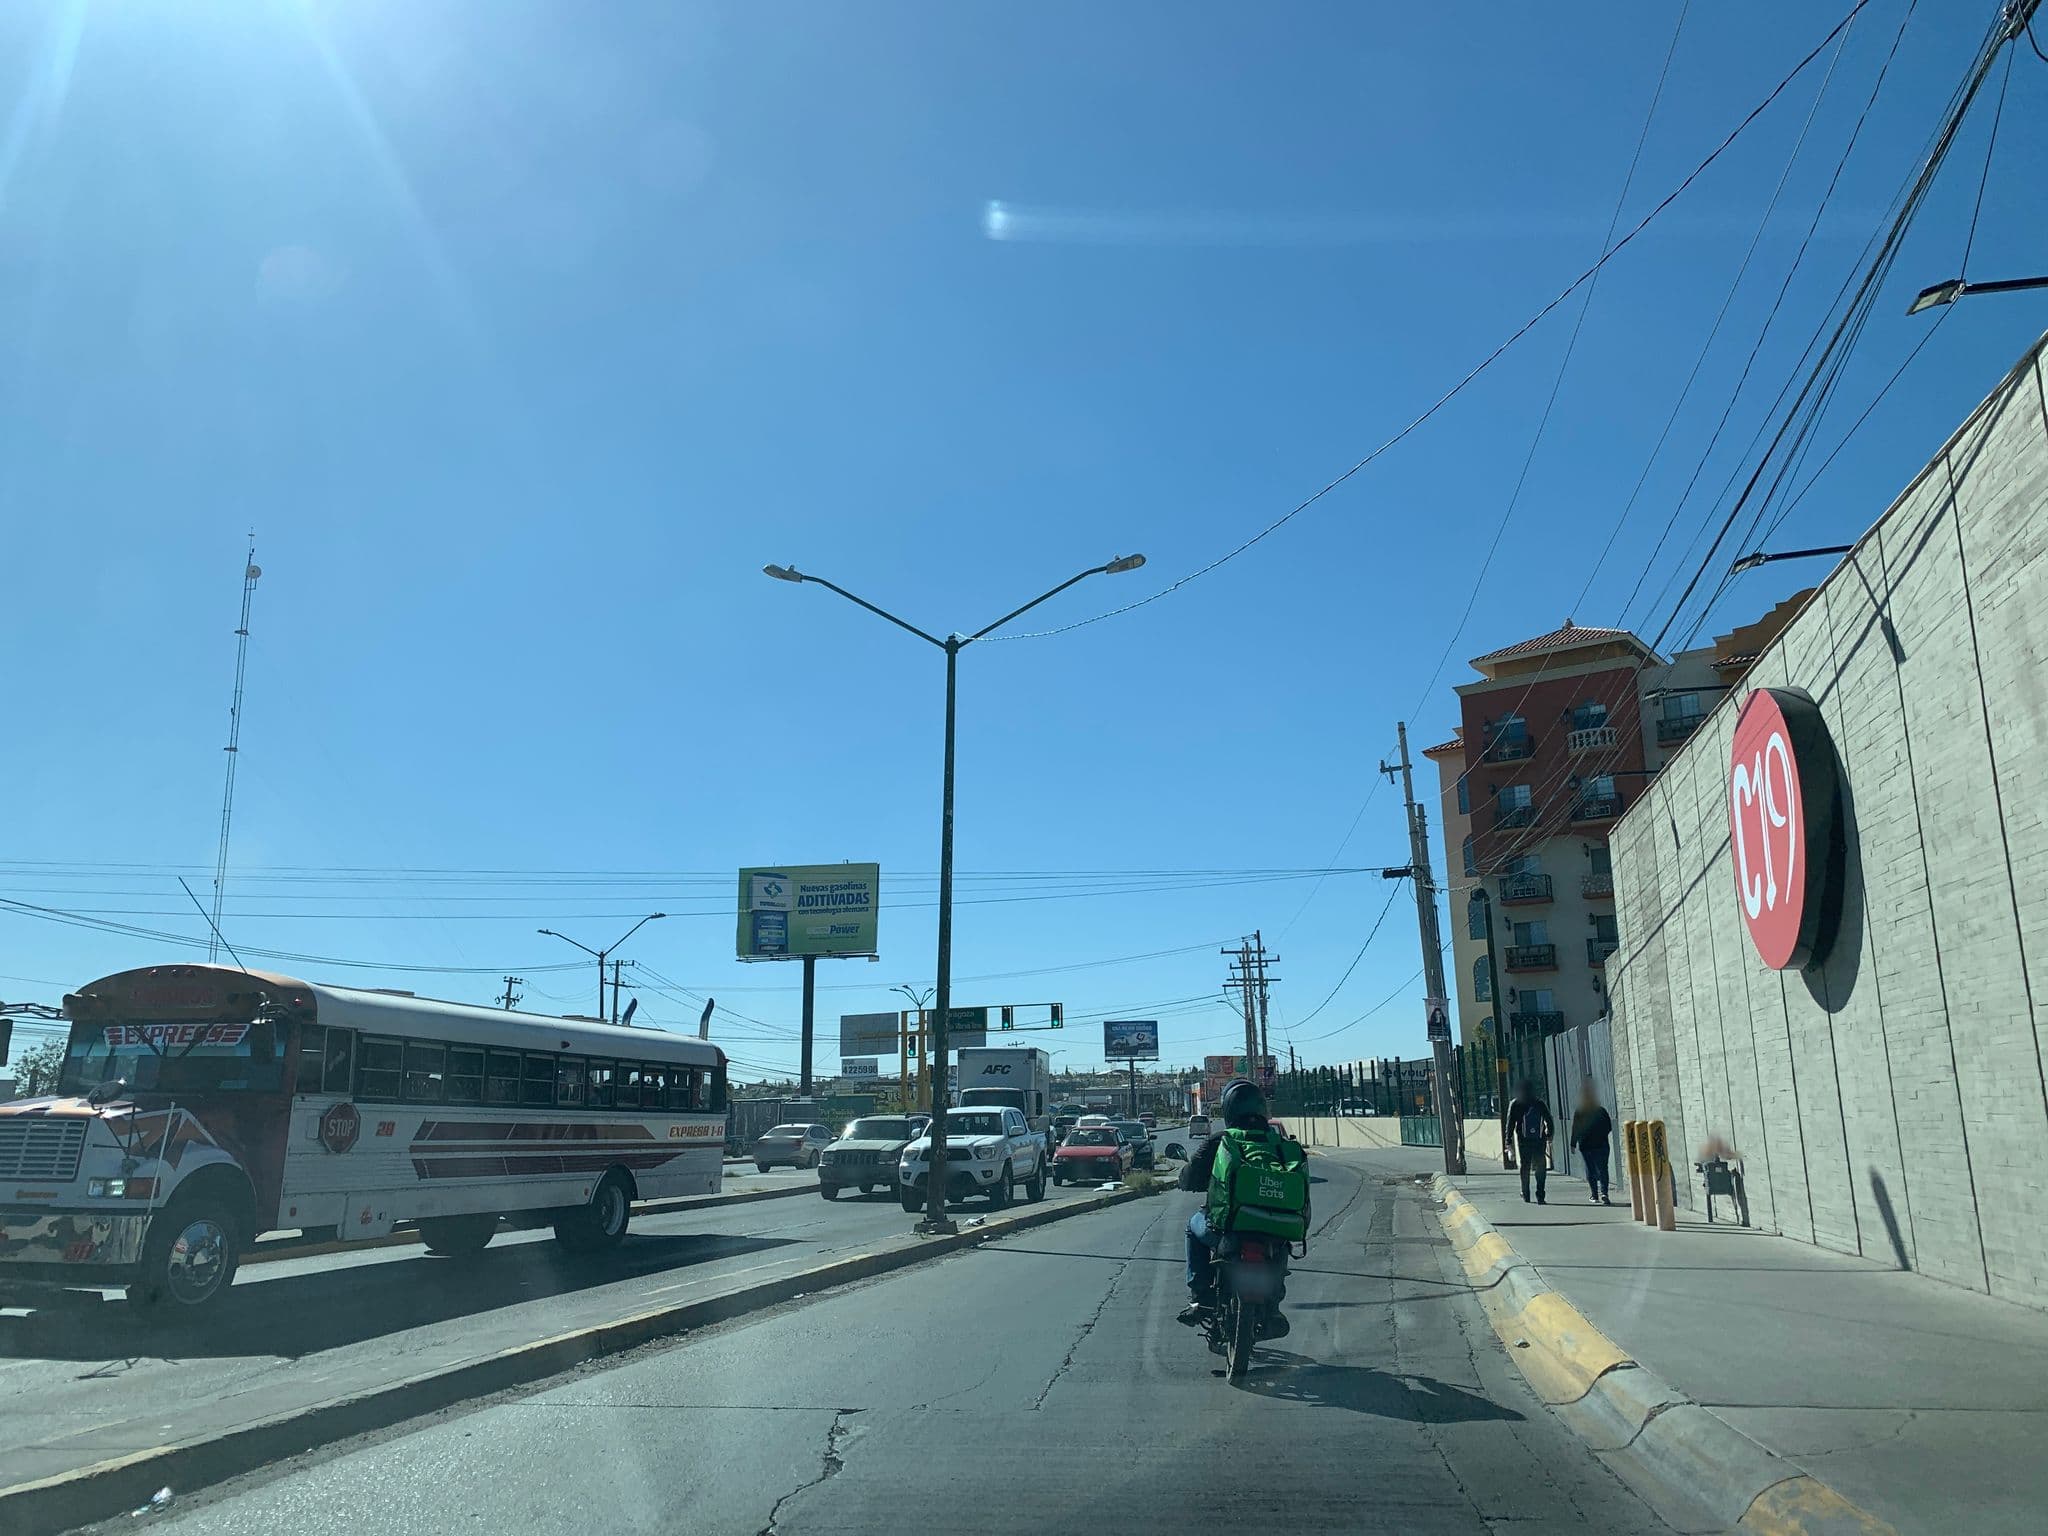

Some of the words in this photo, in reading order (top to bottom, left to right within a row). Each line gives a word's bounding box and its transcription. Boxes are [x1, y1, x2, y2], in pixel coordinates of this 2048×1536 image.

[1733, 731, 1796, 919] C19
[800, 884, 829, 893] Nuevas
[830, 881, 867, 893] gasolinas
[797, 892, 870, 907] ADITIVADAS
[830, 924, 860, 935] Power
[123, 1024, 224, 1045] EXPRESS
[982, 1064, 1012, 1075] AFC
[328, 1119, 355, 1137] STOP
[1259, 1175, 1284, 1189] Uber
[1259, 1186, 1284, 1199] Eats
